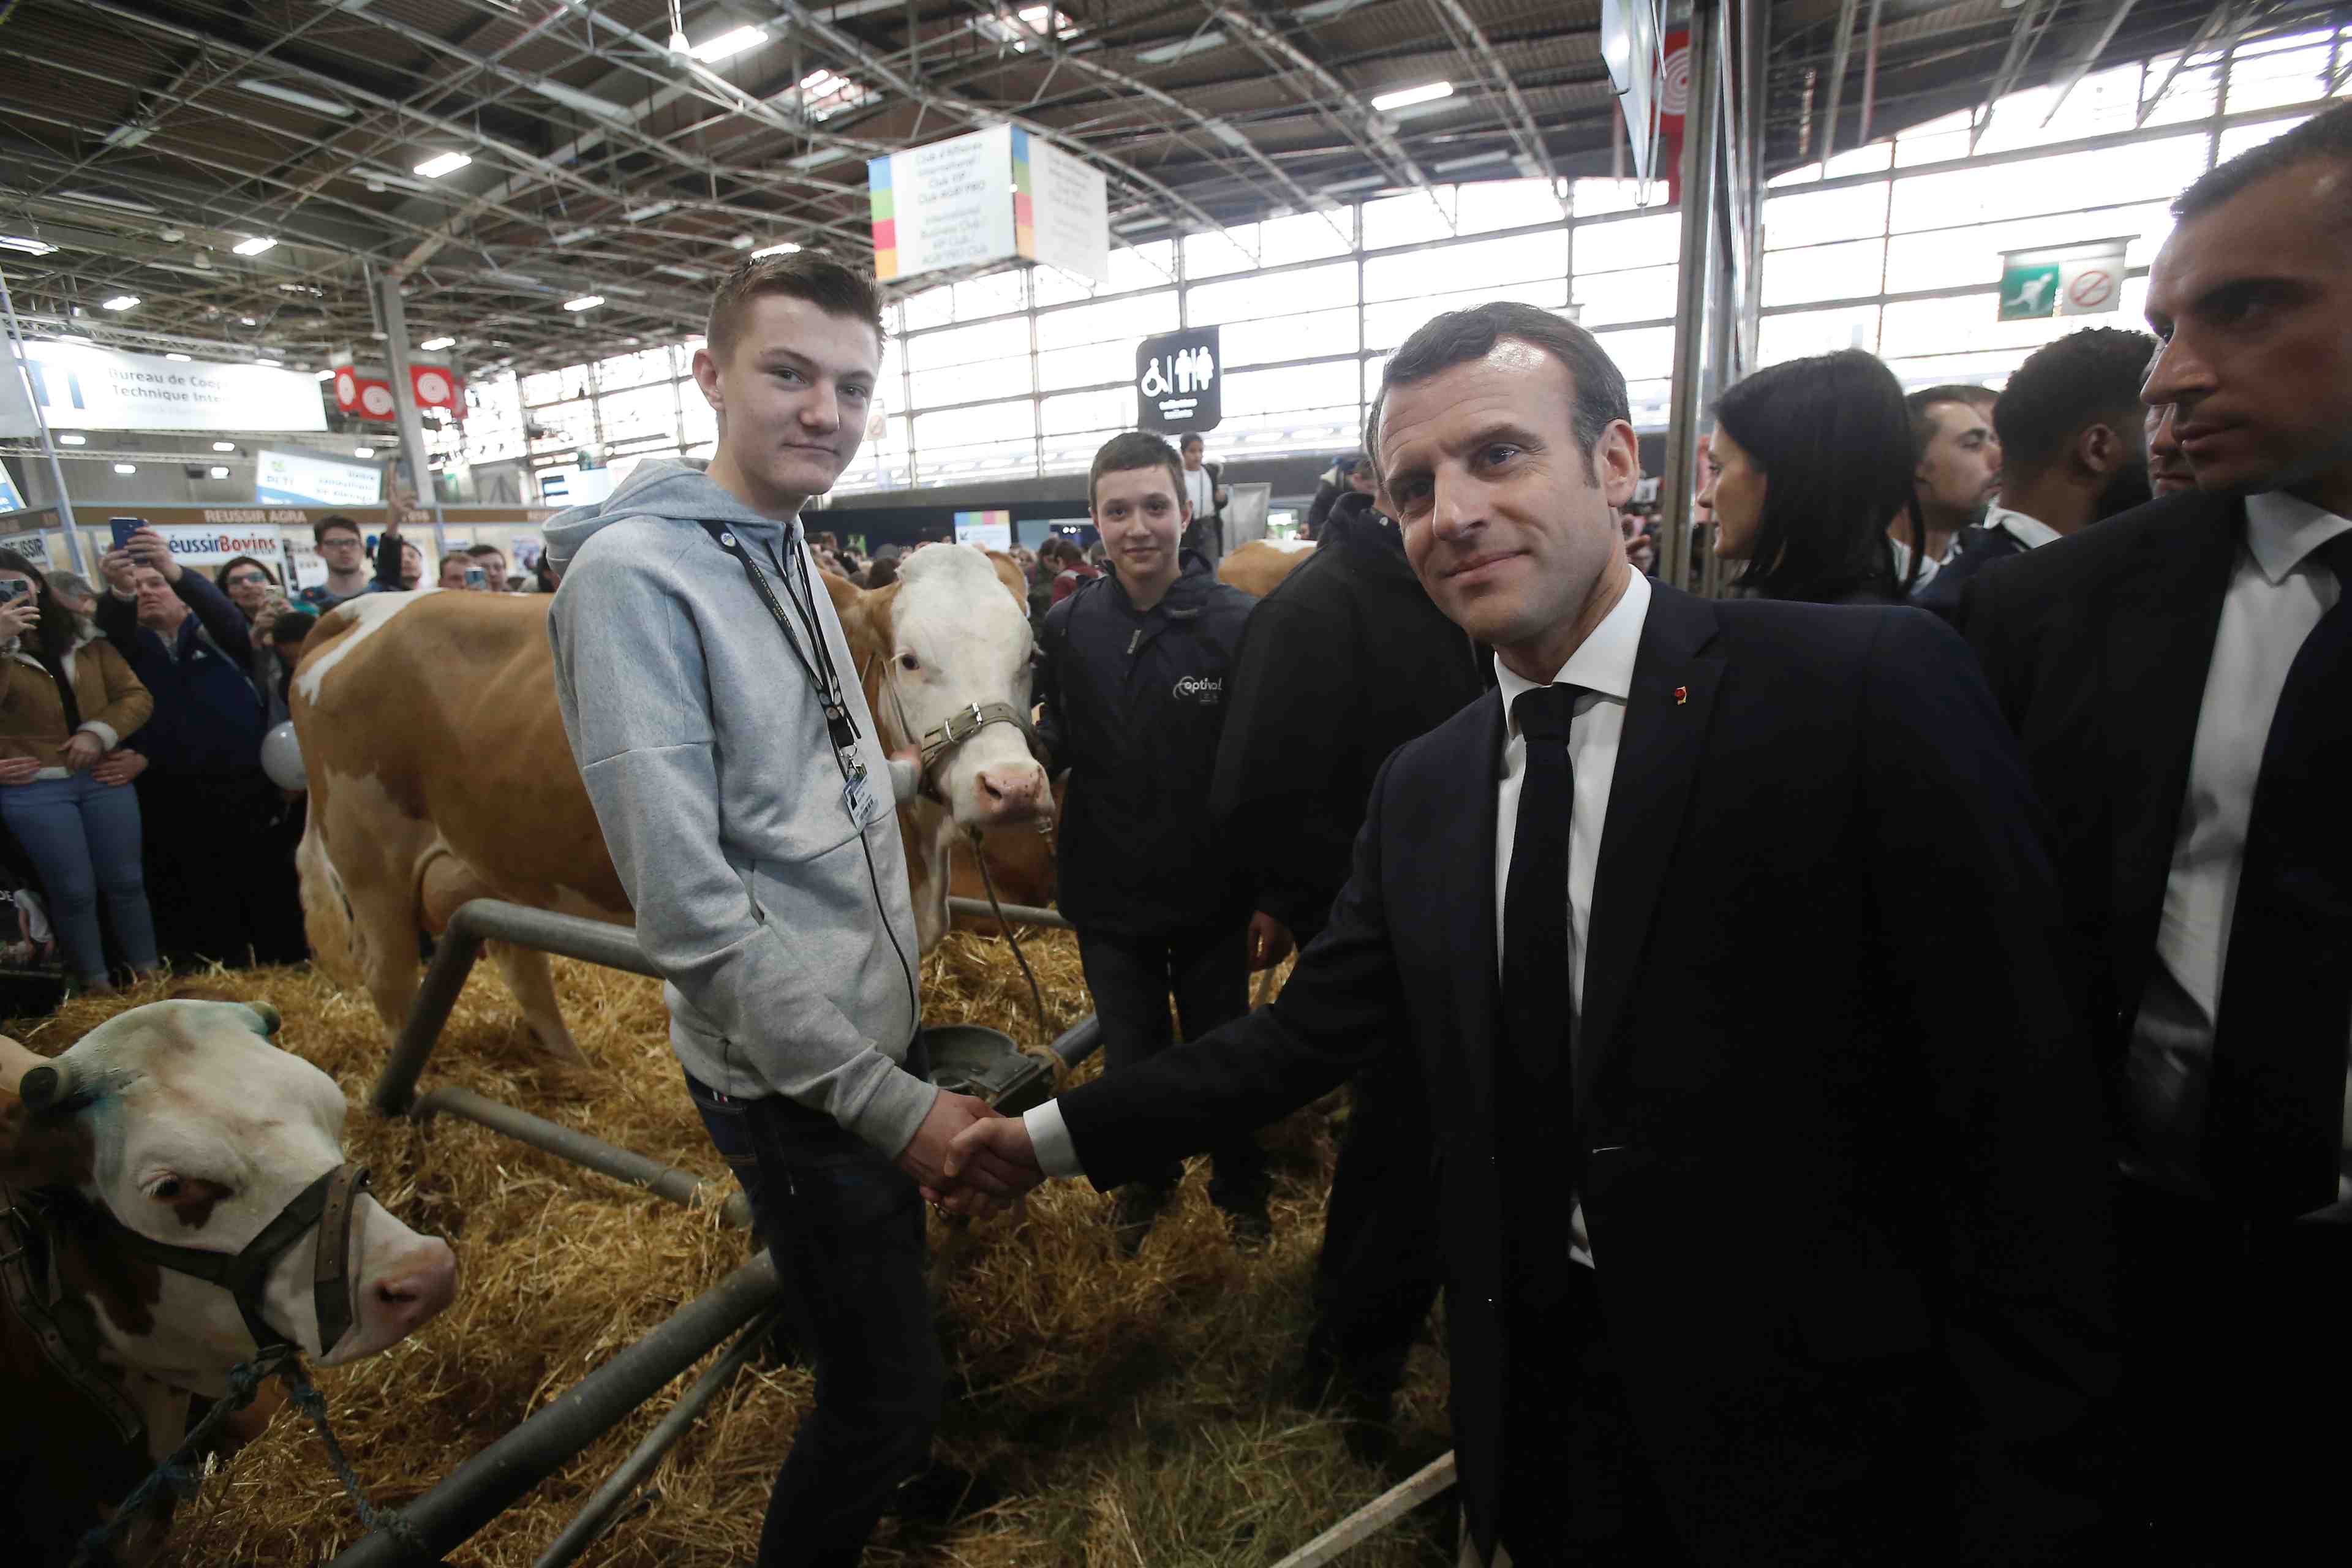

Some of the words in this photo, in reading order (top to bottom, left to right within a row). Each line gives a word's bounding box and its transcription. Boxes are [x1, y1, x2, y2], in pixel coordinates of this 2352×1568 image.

[108, 368, 164, 384] Bureau
[168, 373, 186, 386] de
[112, 384, 190, 402] Technique
